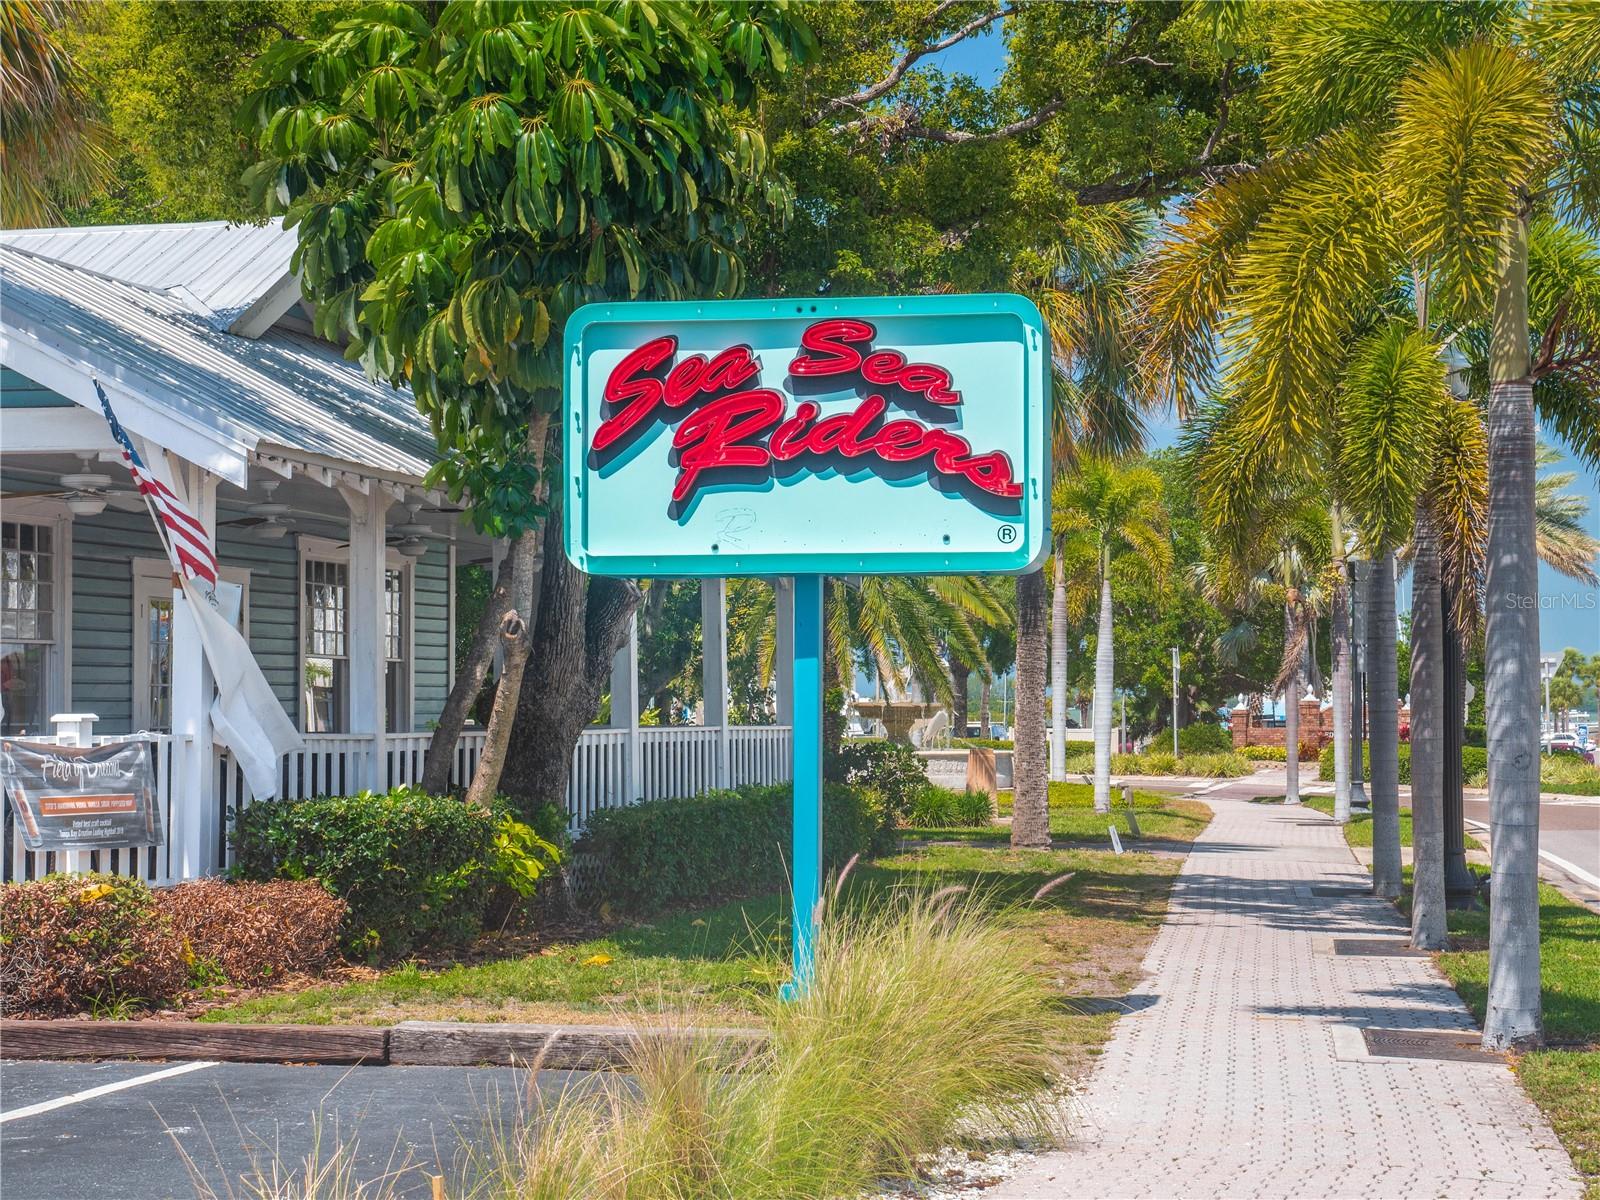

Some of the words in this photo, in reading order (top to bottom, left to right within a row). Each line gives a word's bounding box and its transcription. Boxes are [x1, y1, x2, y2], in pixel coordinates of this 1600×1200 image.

[592, 336, 760, 451] Sea
[788, 319, 961, 405] Sea
[672, 388, 1024, 502] Riders
